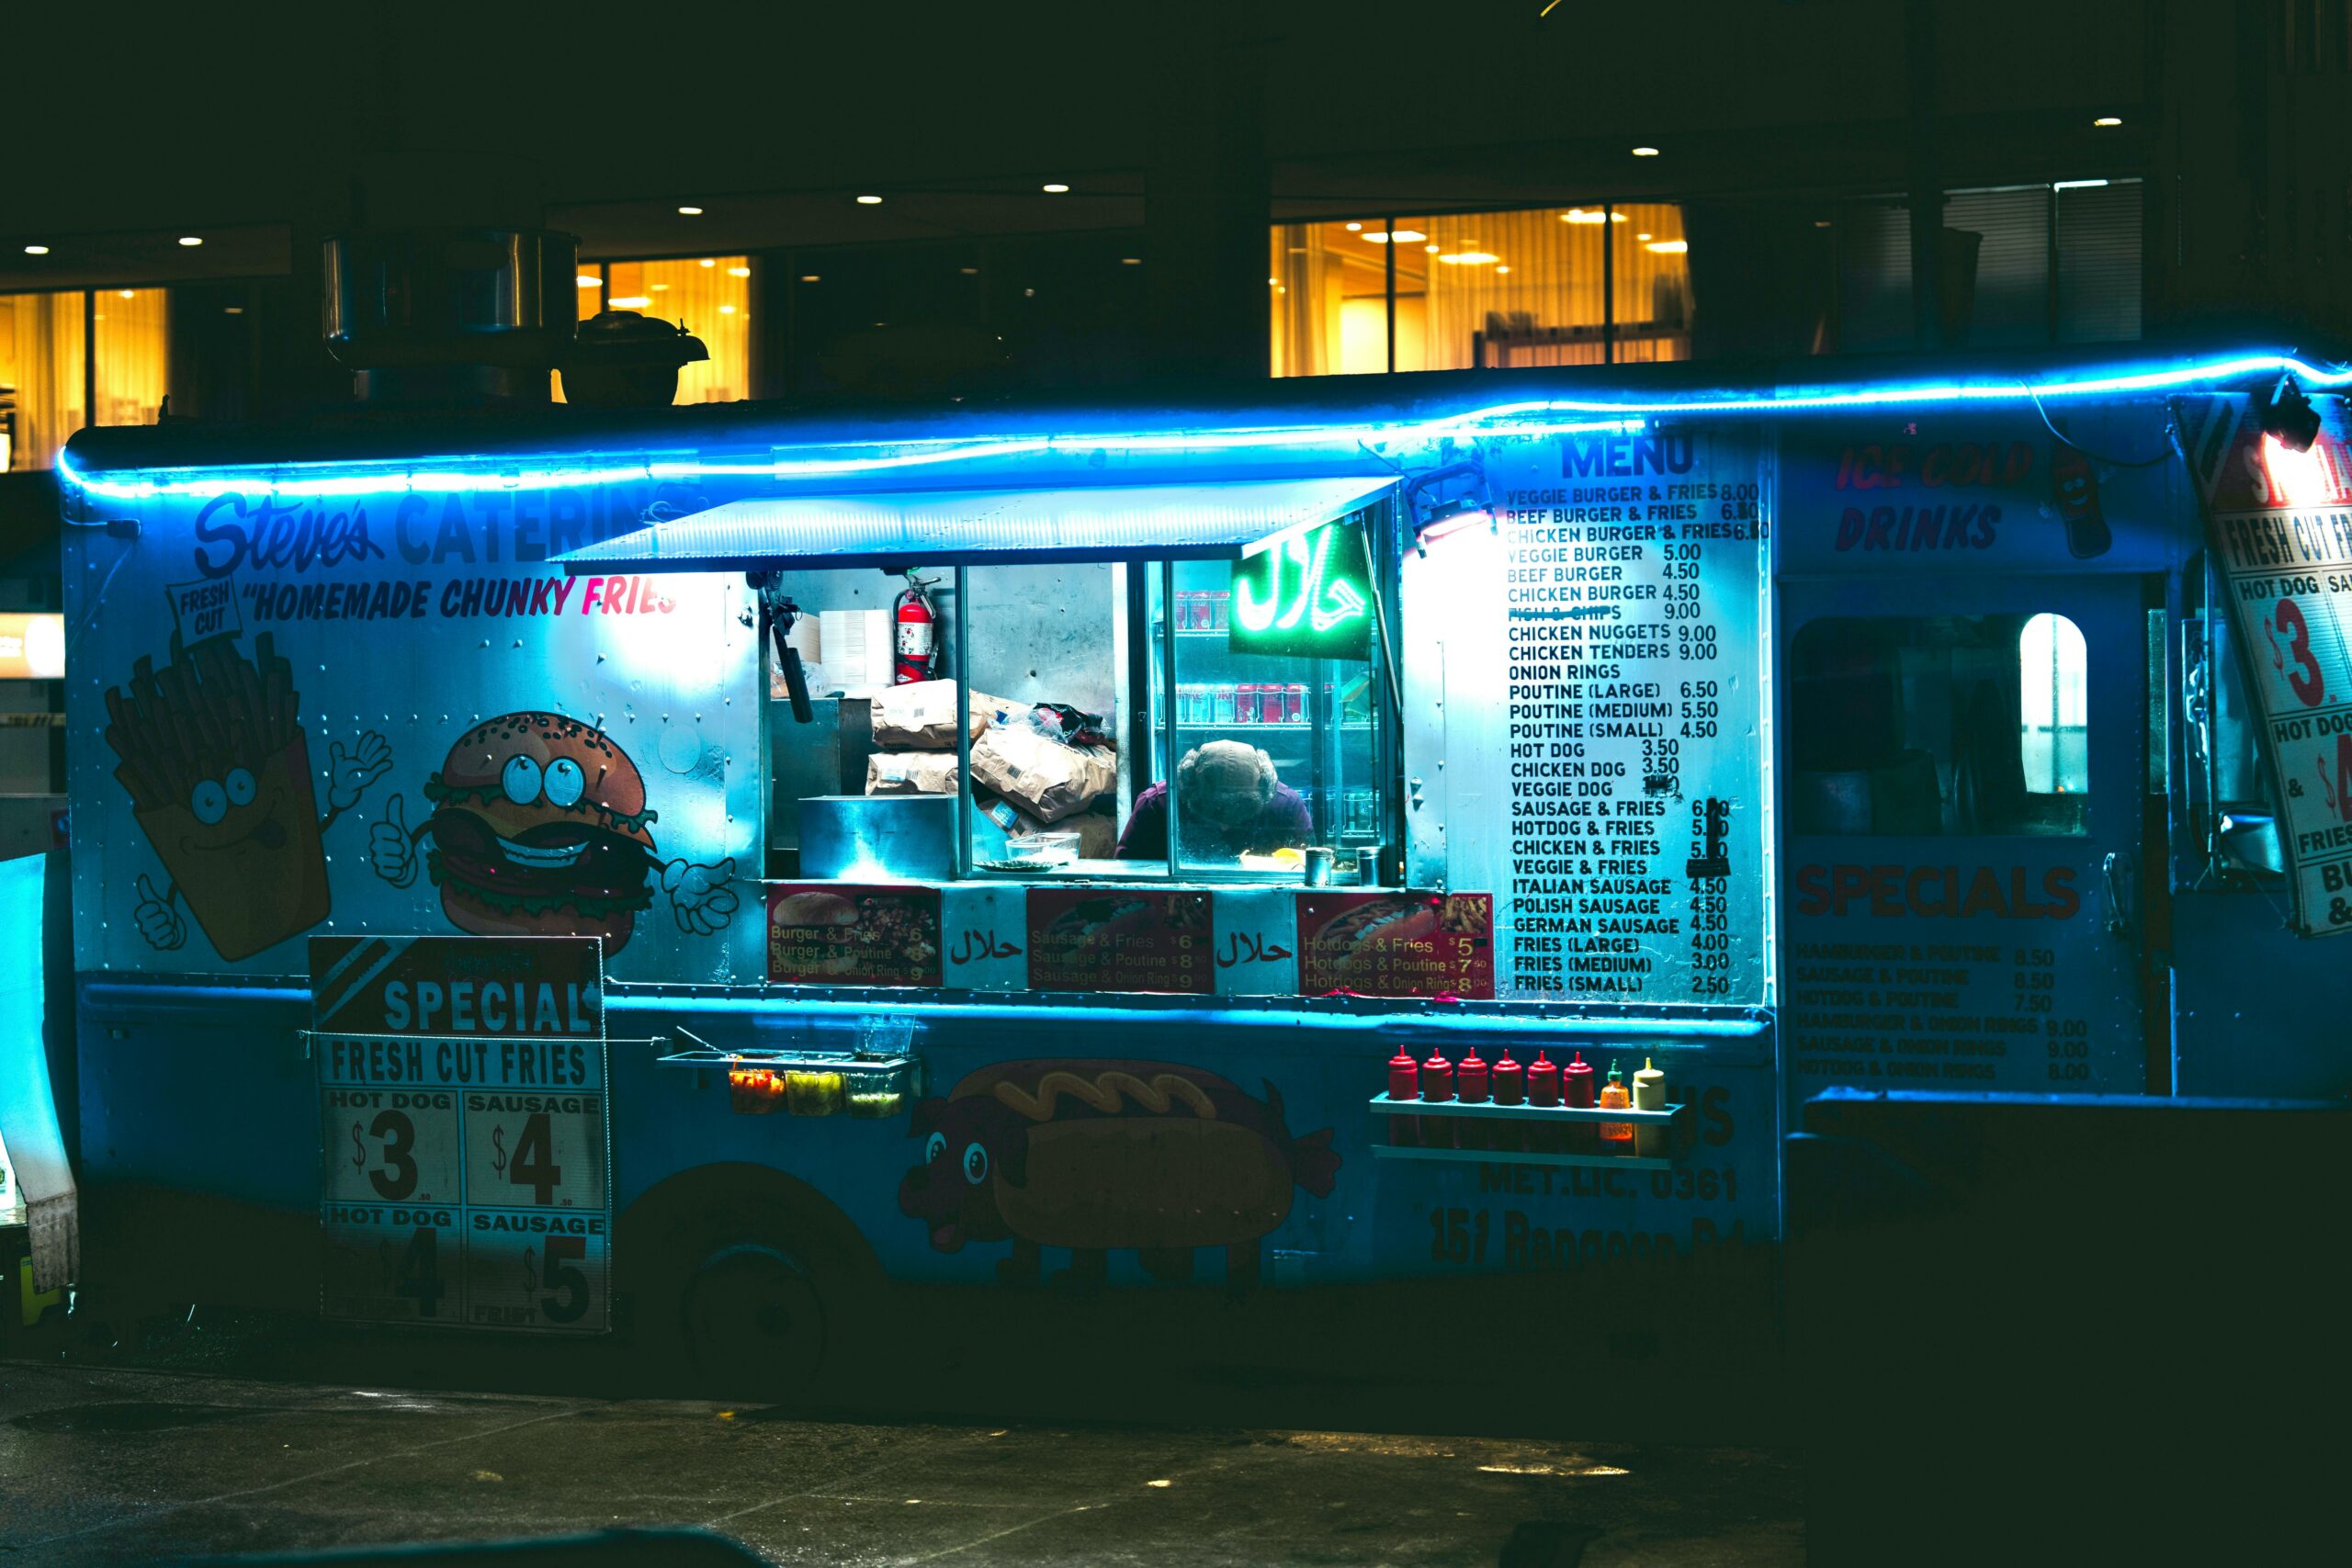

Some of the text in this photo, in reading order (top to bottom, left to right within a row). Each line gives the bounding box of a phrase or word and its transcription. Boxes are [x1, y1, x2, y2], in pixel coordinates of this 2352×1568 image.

[1562, 434, 1693, 479] MENU
[1835, 441, 2033, 491] ICE COLD
[1508, 483, 1758, 505] VEGGIE BURGER & FRIES 8.00
[1507, 502, 1758, 525] BEEF BURGER & FRIES 6.0
[194, 491, 386, 580] Steve's
[1508, 520, 1770, 544] CHICKEN BURGER & FRIES 6.0
[1836, 503, 2002, 552] DRINKS
[2225, 513, 2331, 567] FRESH CUT
[1508, 544, 1701, 563] VEGGIE BURGER 5.00
[1236, 524, 1368, 631] حلال
[1508, 562, 1700, 582] BEEF BURGER 4.50
[180, 581, 230, 616] FRESH
[440, 576, 577, 618] CHUNKY
[1509, 584, 1700, 603] CHICKEN BURGER 4.50
[2240, 576, 2320, 601] HOT DOG
[1664, 602, 1700, 619] 9.00
[195, 606, 226, 636] CUT
[1509, 624, 1716, 642] CHICKEN NUGGETS 9.00
[1510, 644, 1717, 660] CHICKEN TENDERS 9.00
[1510, 664, 1621, 680] ONION RINGS
[1510, 681, 1718, 700] POUTINE (LARGE) 6.50
[1510, 702, 1718, 719] POUTINE (MEDIUM) 5.50
[1510, 721, 1717, 739] POUTINE (SMALL) 4.50
[2274, 720, 2312, 743] HOT
[1510, 739, 1679, 758] HOT DOG 3.50
[1511, 758, 1679, 777] CHICKEN DOG 3.50
[1512, 782, 1612, 796] VEGGIE DOG
[2289, 778, 2305, 798] &
[1511, 800, 1730, 818] SAUSAGE & FRIES 6.0
[1512, 819, 1730, 837] HOTDOG & FRIES 5.0
[1512, 840, 1728, 859] CHICKEN & FRIES 5.0
[1512, 860, 1647, 874] VEGGIE & FRIES
[1513, 877, 1727, 895] ITALIAN SAUSAGE 4.50
[1795, 863, 2081, 919] SPECIALS
[1513, 897, 1727, 914] POLISH SAUSAGE 4.50
[2328, 897, 2352, 925] &
[771, 925, 820, 942] Burger
[827, 927, 838, 941] &
[1513, 914, 1728, 934] GERMAN SAUSAGE 4.50
[950, 929, 1023, 965] حلال
[1031, 930, 1095, 947] Sausage
[1099, 933, 1111, 947] &
[1115, 933, 1154, 948] Fries
[1303, 937, 1371, 956] Hotdogs
[1375, 938, 1387, 953] &
[1393, 938, 1433, 953] Fries
[1514, 933, 1729, 953] FRIES (LARGE) 4.00
[1216, 931, 1293, 968] حلال
[1304, 956, 1373, 974] Hotdogs
[1376, 956, 1388, 972] &
[1393, 958, 1447, 973] Poutine
[1514, 953, 1729, 973] FRIES (MEDIUM) 3.00
[1515, 976, 1729, 994] FRIES (SMALL) 2.50
[383, 979, 593, 1032] SPECIAL
[331, 1041, 586, 1086] FRESH CUT FRIES
[330, 1091, 451, 1111] HOT DOG
[468, 1096, 600, 1115] SAUSAGE
[1650, 1168, 1737, 1201] 0361
[330, 1207, 453, 1228] HOT DOG
[473, 1213, 606, 1236] SAUSAGE
[1429, 1205, 1489, 1266] 151
[1504, 1209, 1677, 1270] Rangoon
